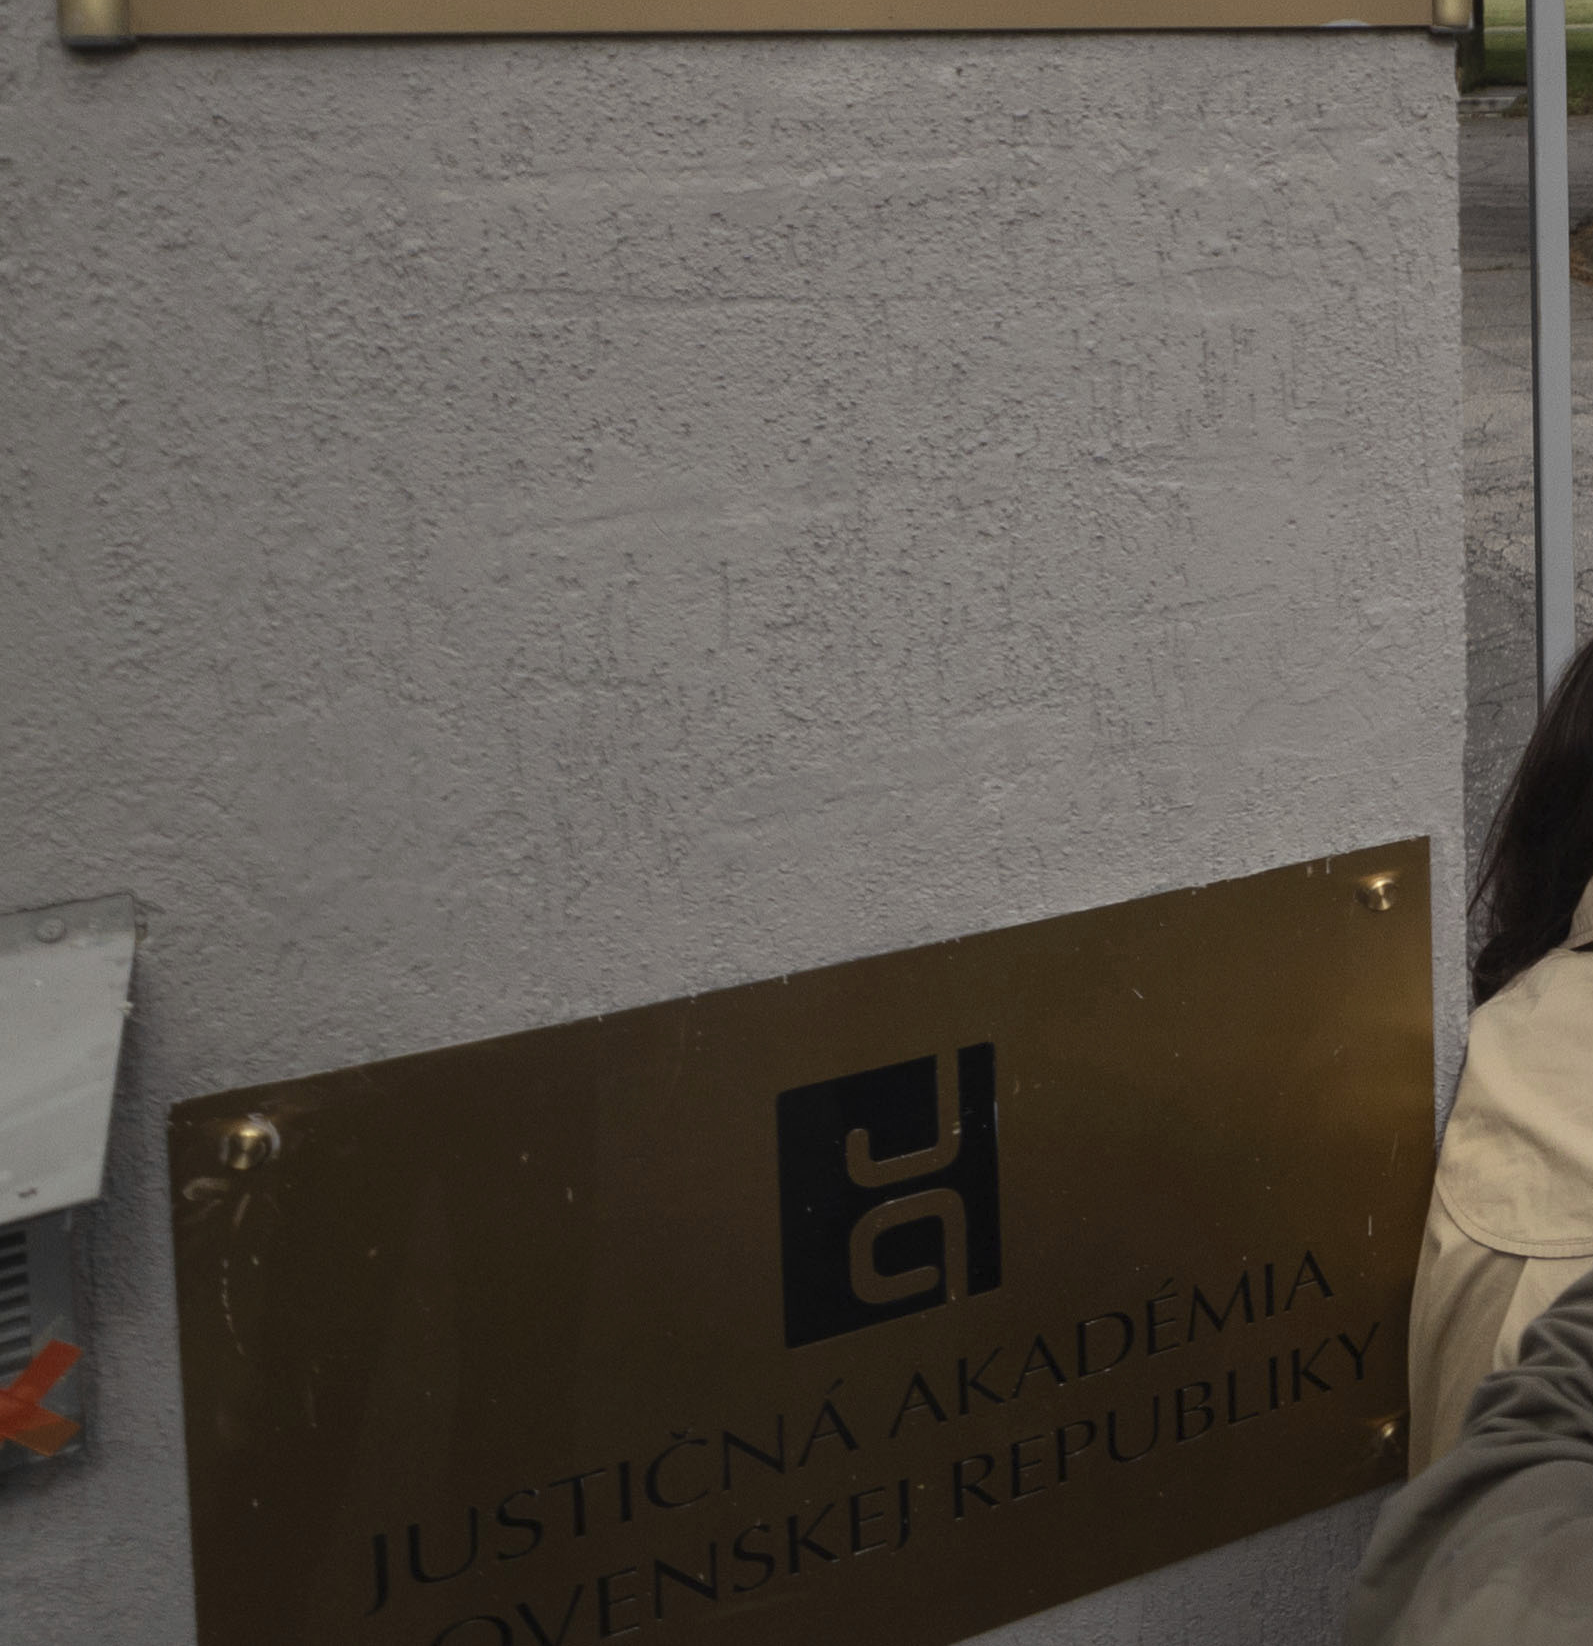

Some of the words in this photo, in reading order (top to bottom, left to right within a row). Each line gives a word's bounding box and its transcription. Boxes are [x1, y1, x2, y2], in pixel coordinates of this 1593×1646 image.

[366, 1379, 860, 1617] JUSTIČNÁ
[889, 1250, 1334, 1439] AKADÉMIA
[952, 1322, 1381, 1521] REPUBLIKY
